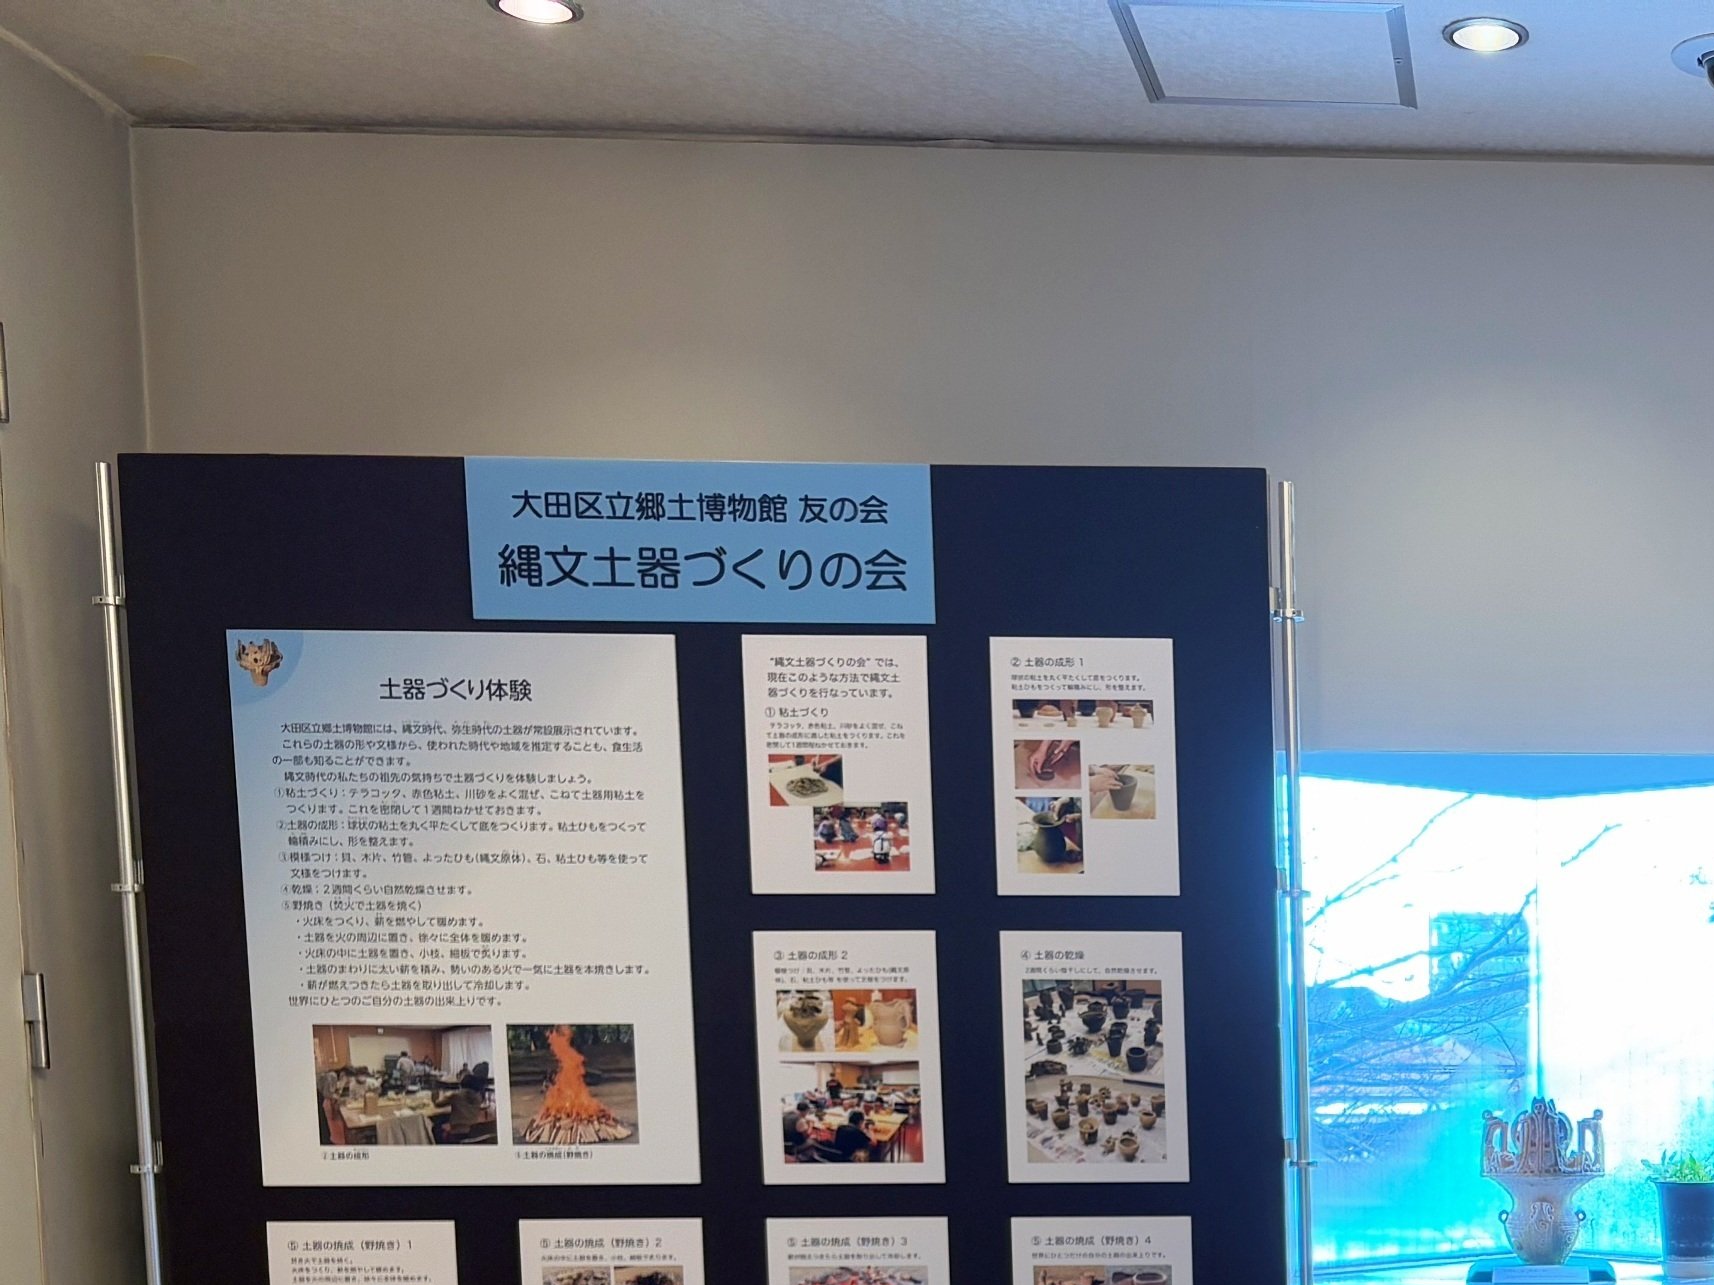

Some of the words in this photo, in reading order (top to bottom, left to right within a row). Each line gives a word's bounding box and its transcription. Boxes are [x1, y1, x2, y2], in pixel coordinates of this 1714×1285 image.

[512, 489, 788, 523] 大田区立郷土博物館
[799, 494, 889, 525] 友の会
[498, 543, 907, 592] 縄文土器づくりの会
[1025, 657, 1075, 667] 土器の成形
[379, 678, 533, 703] 土器づくり体験
[779, 707, 829, 717] 粘土づくり
